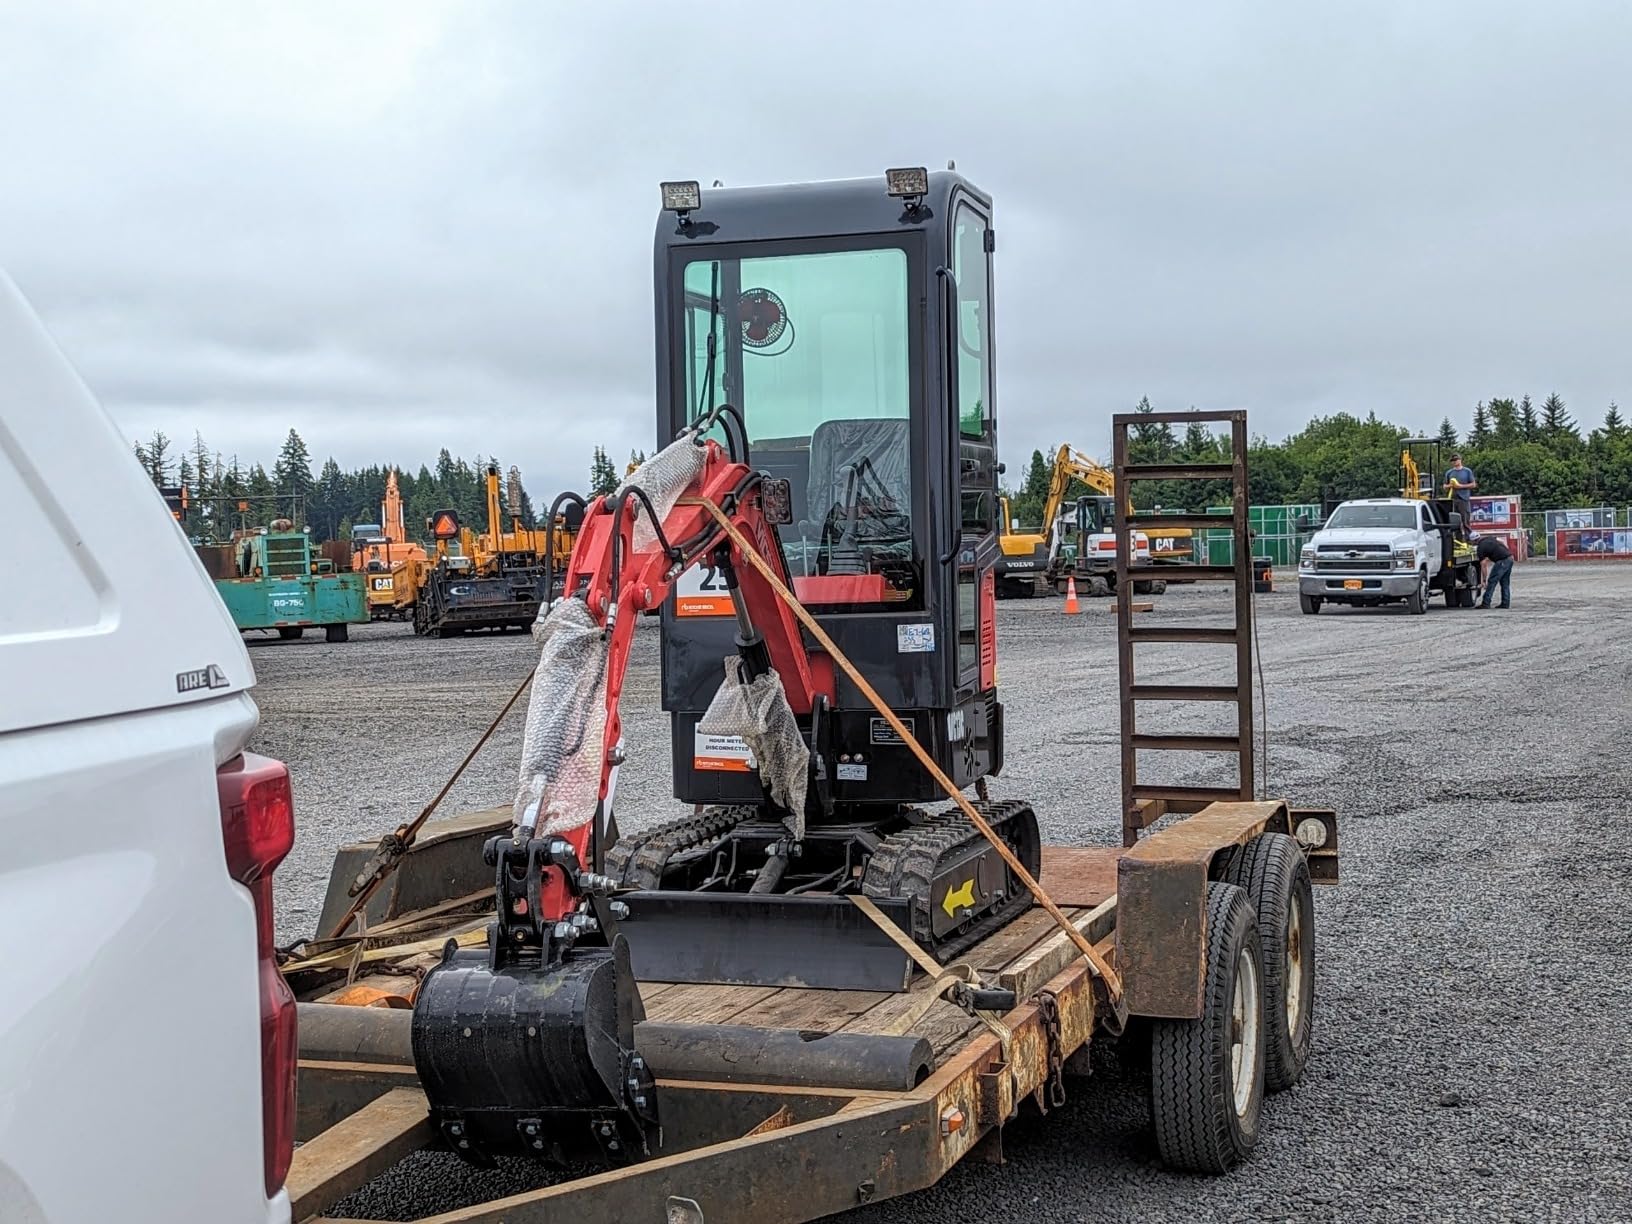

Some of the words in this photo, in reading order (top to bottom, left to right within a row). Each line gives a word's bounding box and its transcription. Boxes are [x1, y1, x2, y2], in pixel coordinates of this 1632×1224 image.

[1155, 538, 1174, 551] CAT
[375, 578, 393, 590] CAT
[178, 670, 208, 691] ARE
